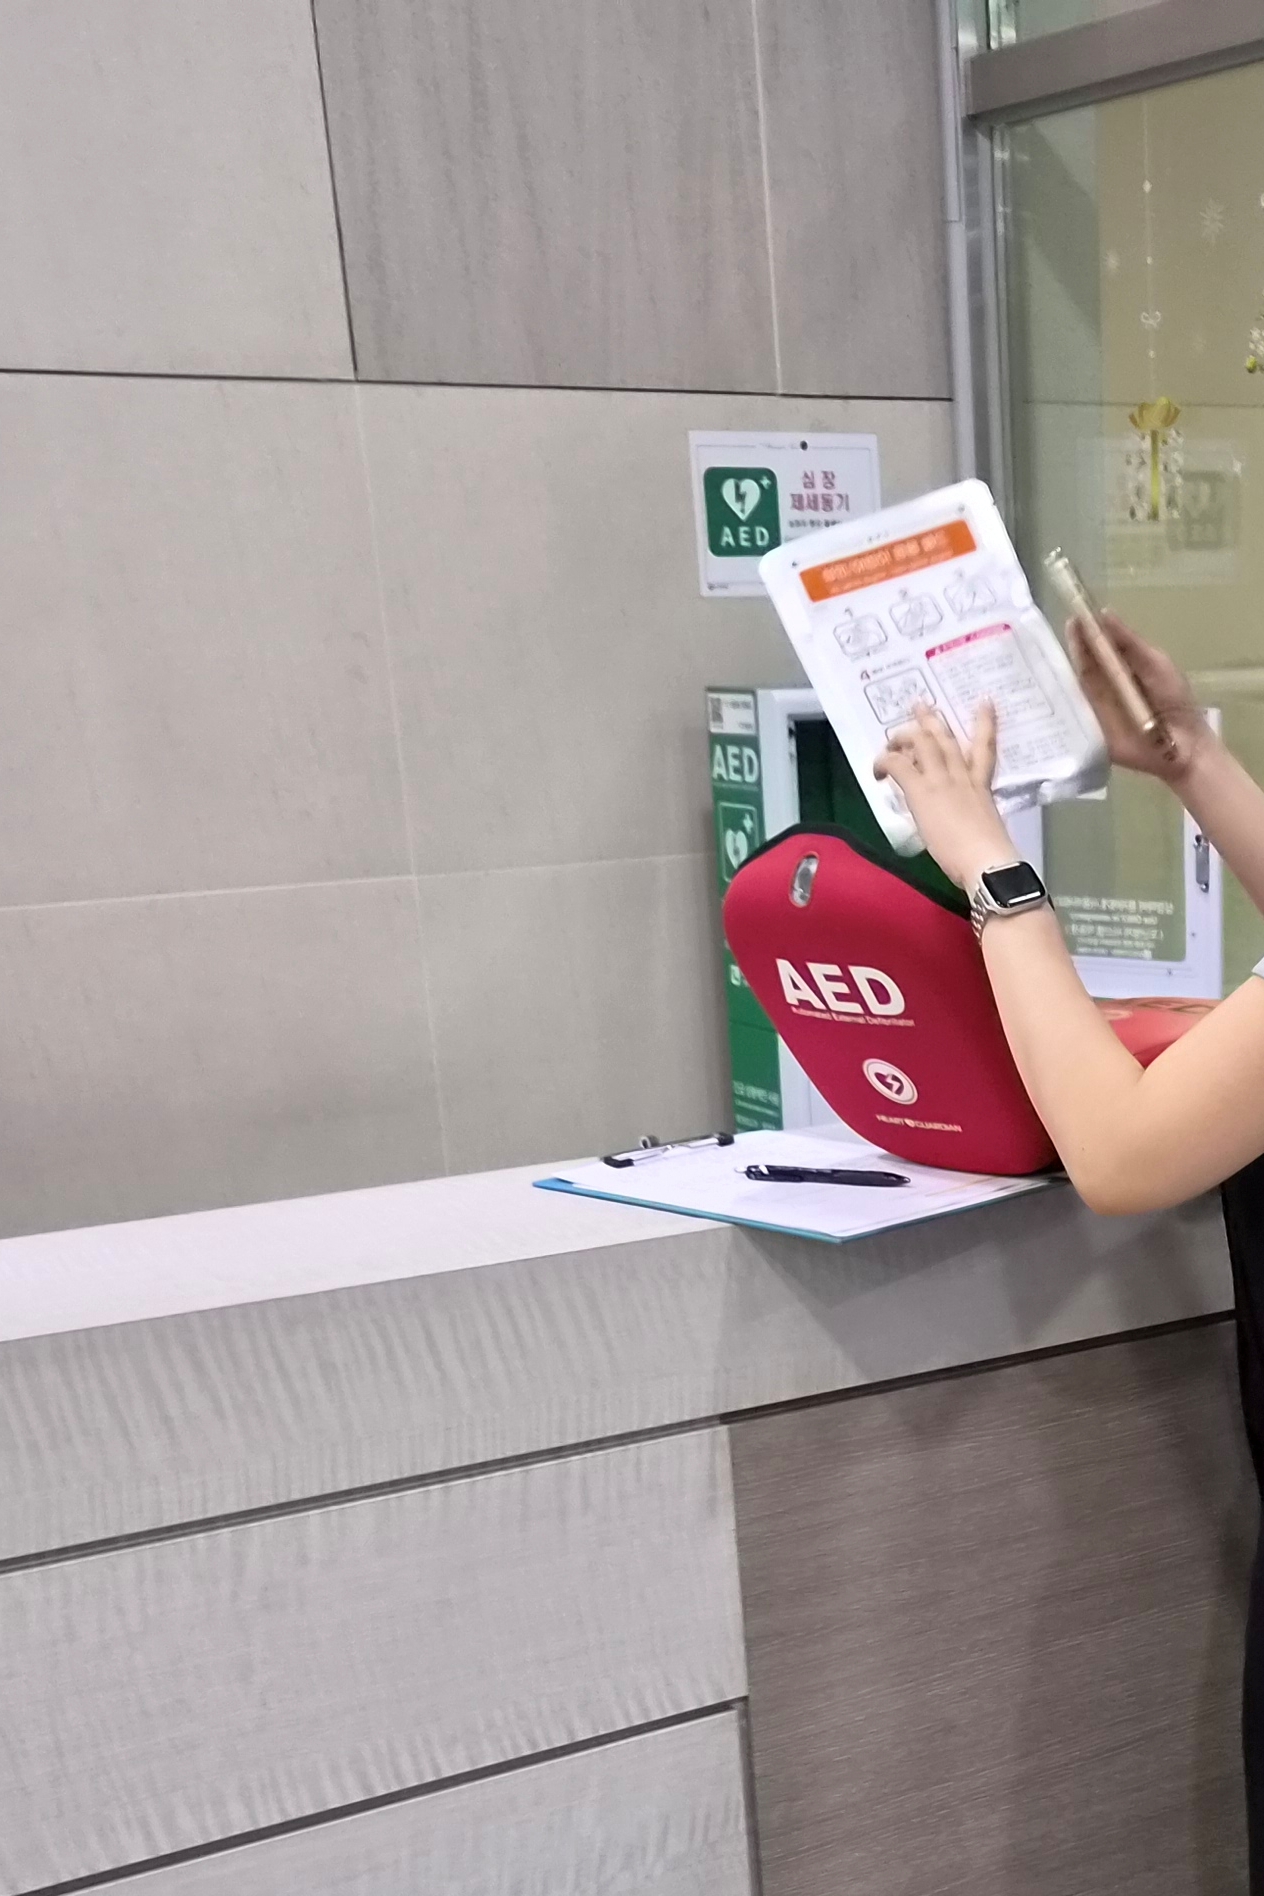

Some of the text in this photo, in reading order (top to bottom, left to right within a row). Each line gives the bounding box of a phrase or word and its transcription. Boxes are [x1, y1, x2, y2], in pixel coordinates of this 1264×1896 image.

[790, 493, 850, 512] 제세동기
[720, 526, 770, 547] AED
[712, 743, 760, 783] AED
[775, 957, 906, 1016] AED
[875, 1114, 963, 1133] HEART GUARDIAN
